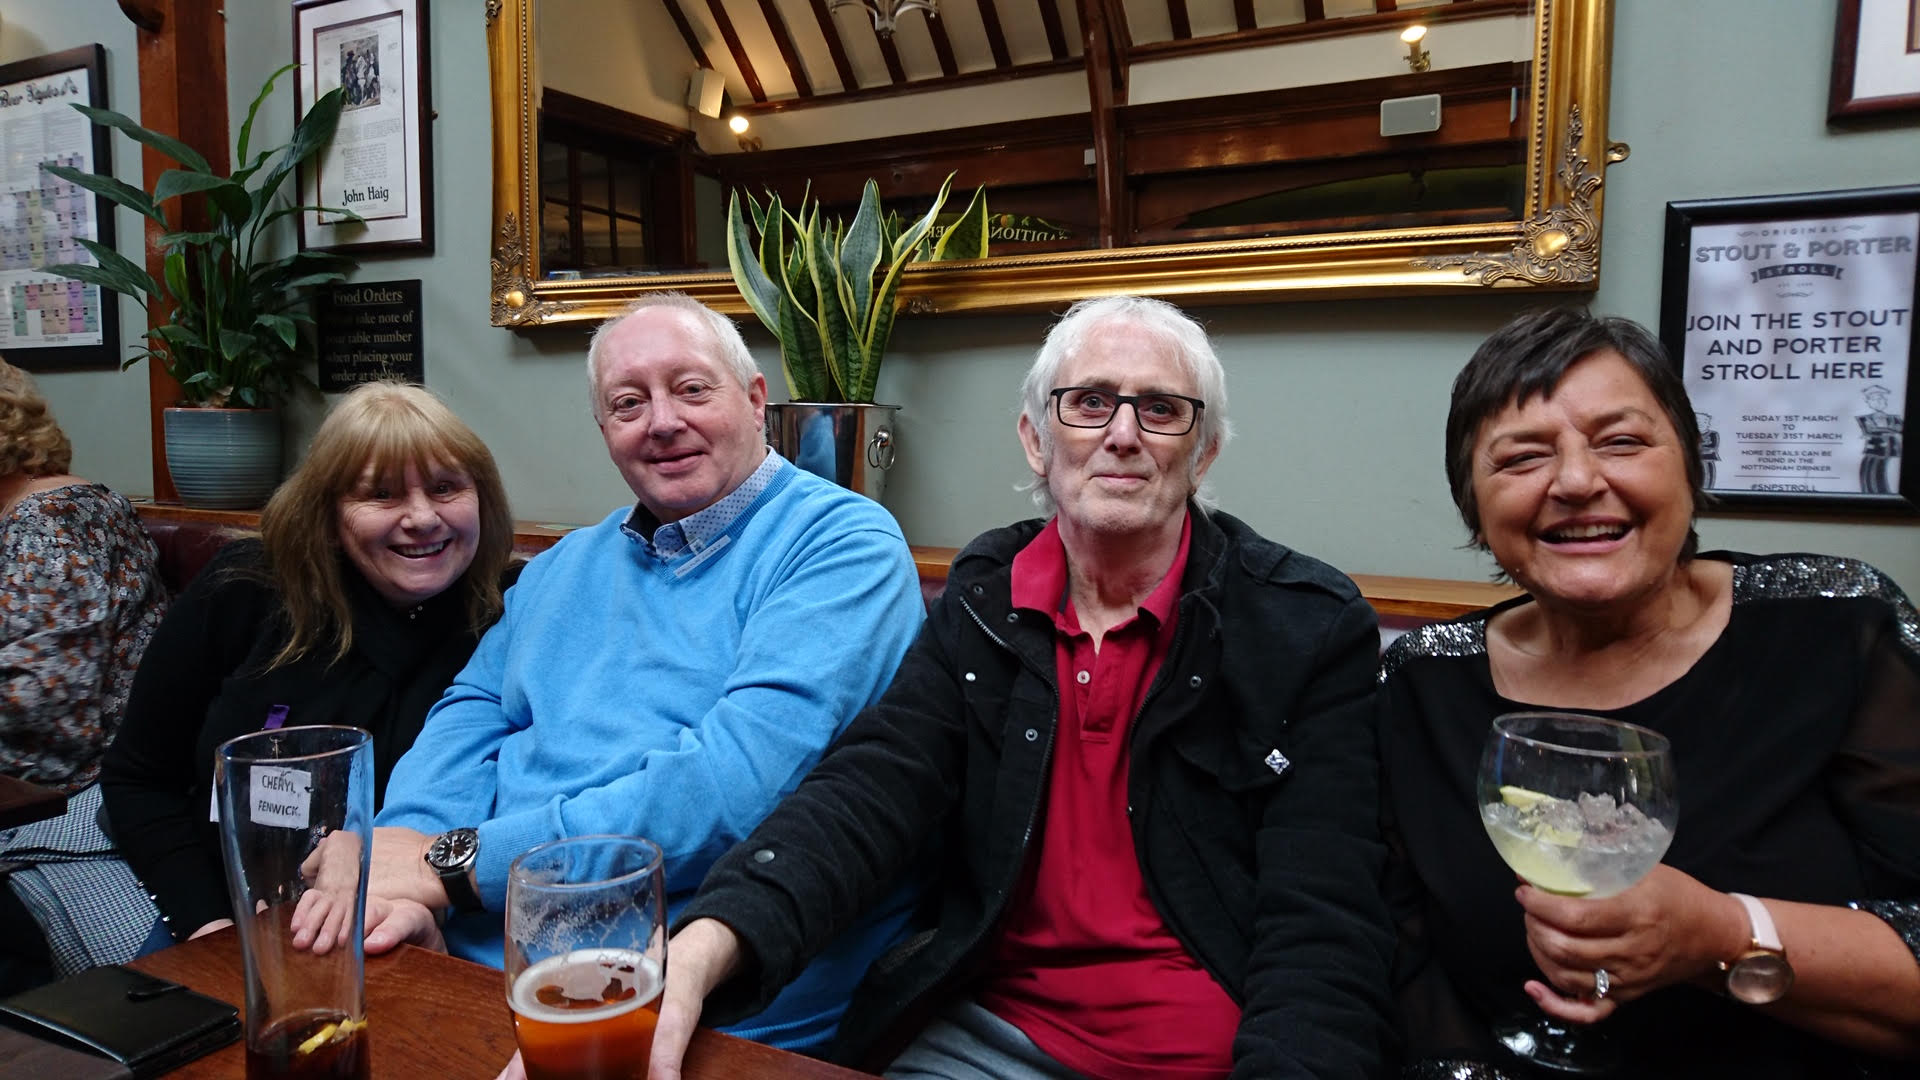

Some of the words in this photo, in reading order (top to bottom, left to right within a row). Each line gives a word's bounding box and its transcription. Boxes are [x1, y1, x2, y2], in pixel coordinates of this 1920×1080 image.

[342, 189, 365, 206] John
[367, 186, 389, 202] Haig
[1761, 226, 1838, 237] ORIGINAL
[1695, 243, 1777, 263] STOUT
[1783, 242, 1800, 259] &
[1807, 236, 1912, 258] PORTER
[1764, 264, 1829, 277] STROLL
[363, 287, 403, 302] Orders
[378, 313, 400, 323] note
[402, 310, 414, 323] of
[1687, 314, 1740, 332] JOIN
[1751, 313, 1802, 330] THE
[1813, 309, 1909, 328] STOUT
[373, 331, 412, 342] number
[1707, 339, 1762, 355] AND
[1773, 336, 1882, 354] PORTER
[352, 349, 388, 366] placing
[390, 352, 413, 365] your
[1701, 364, 1800, 380] STROLL
[1811, 362, 1884, 379] HERE
[1736, 432, 1779, 440] TUESDAY
[1807, 432, 1843, 440] MARCH
[262, 774, 296, 794] CHERYL
